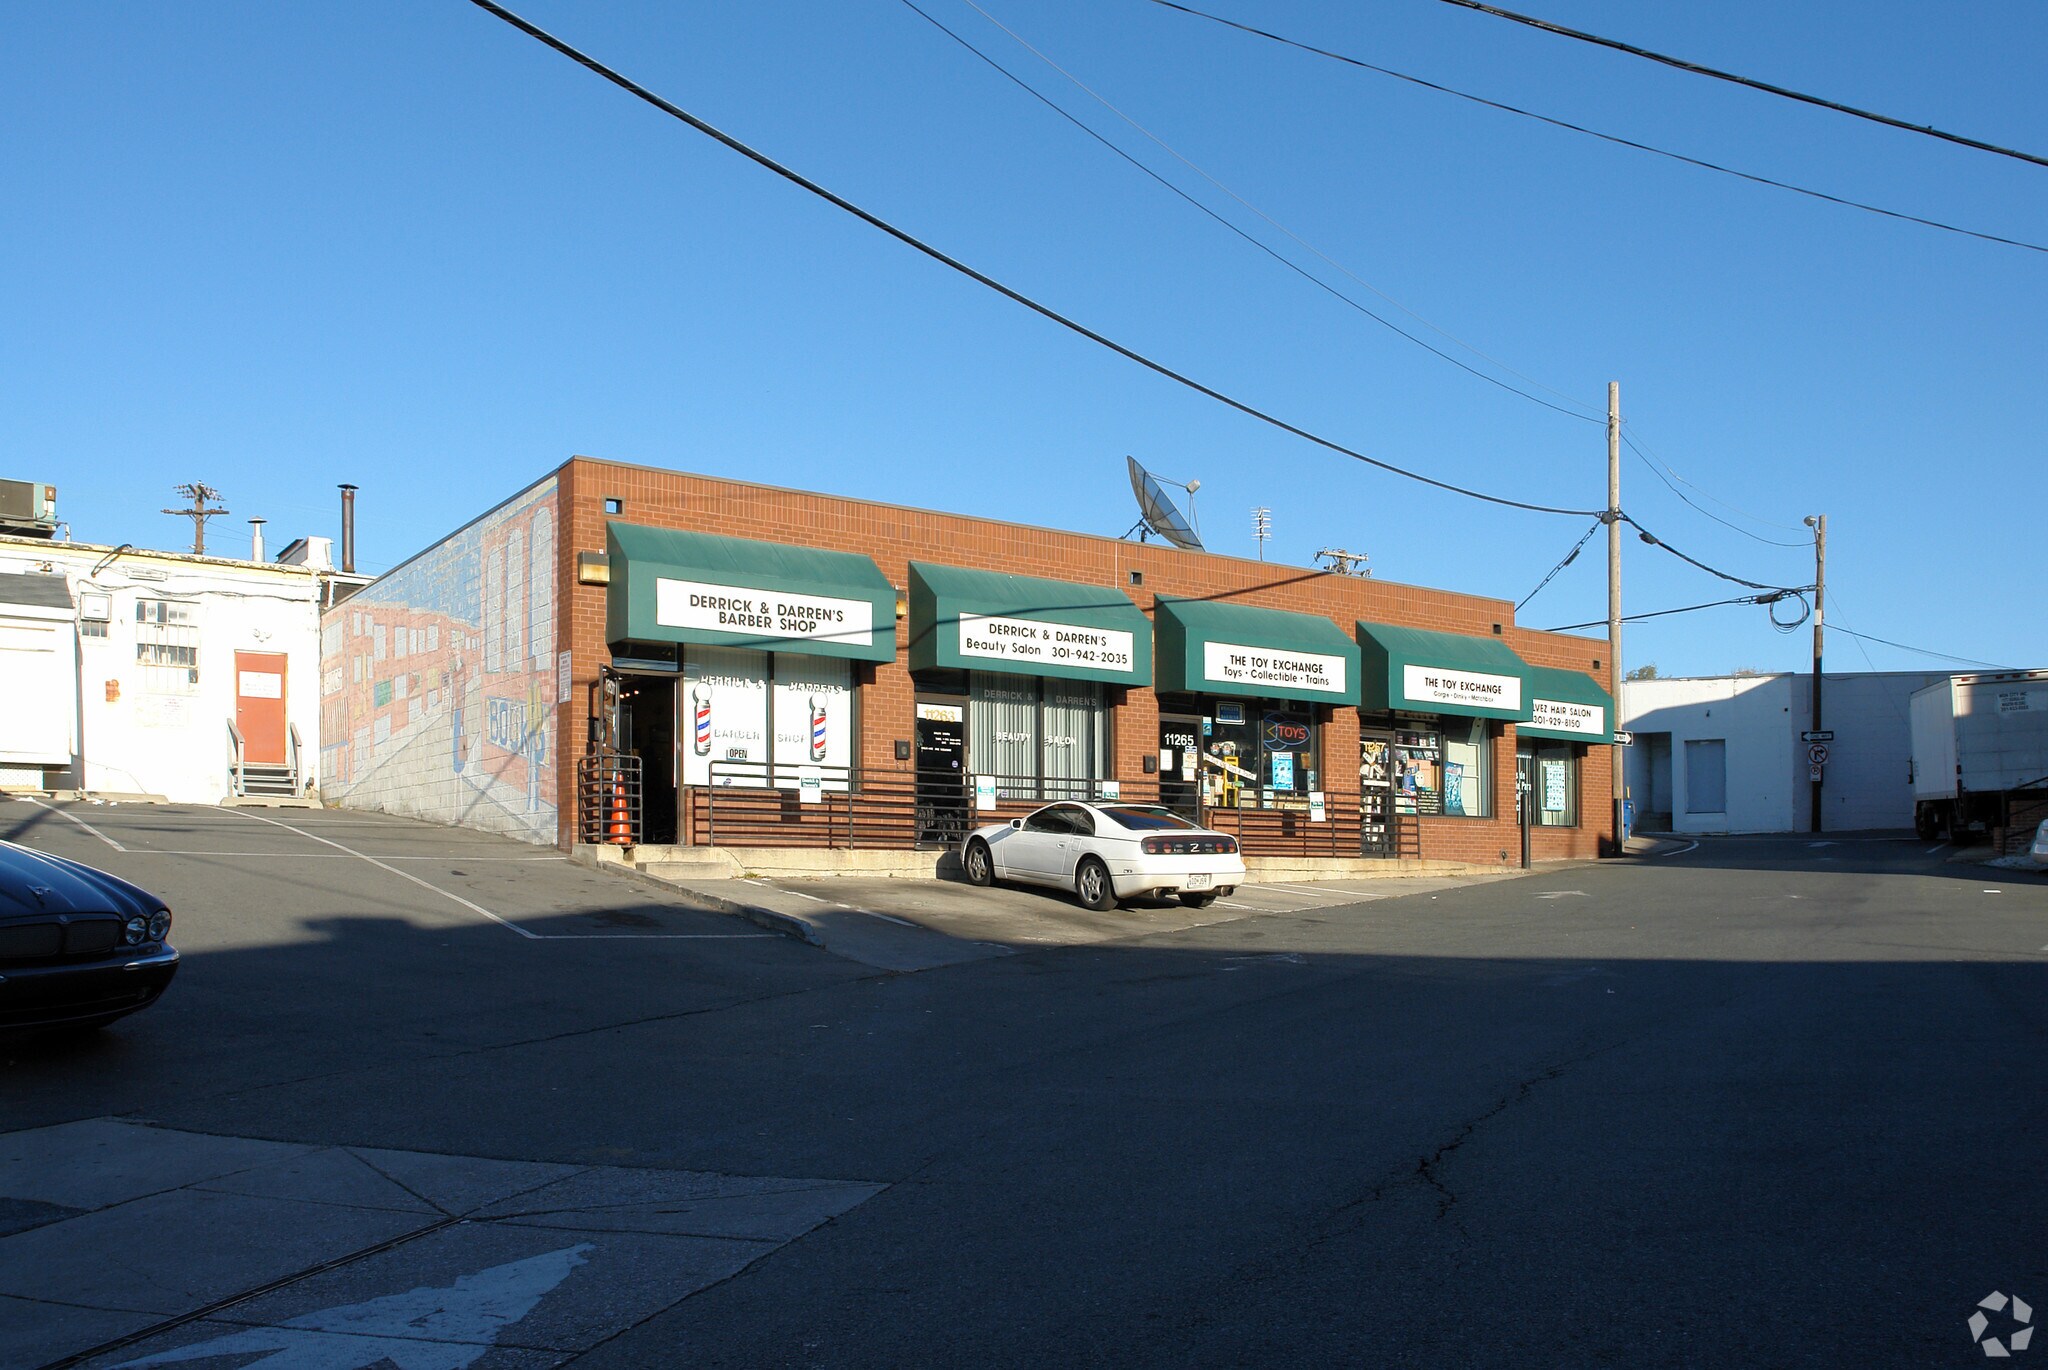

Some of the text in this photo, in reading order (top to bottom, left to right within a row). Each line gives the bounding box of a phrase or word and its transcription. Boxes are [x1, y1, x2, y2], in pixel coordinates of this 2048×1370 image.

[689, 594, 844, 622] DERRICK & DARREN'S
[718, 611, 817, 633] BARBER SHOP
[989, 623, 1107, 647] DERRICK & DARREN'S
[966, 638, 1128, 664] Beauty Salon 301-942-2035
[1230, 654, 1324, 674] THE TOY EXCHANGE
[1224, 666, 1330, 686] Toys Collectible Trains
[1425, 677, 1502, 694] THE TOY EXCHANGE
[984, 689, 1022, 700] DERRICK
[1056, 695, 1097, 706] DARREN'S
[924, 708, 956, 722] 11263
[1533, 704, 1592, 718] VEZ HAIR SALON
[1533, 715, 1581, 728] 301-929-8150
[996, 731, 1077, 746] BEAUTY SALON
[1164, 733, 1194, 746] 11265
[1278, 725, 1306, 740] TOYS
[730, 749, 748, 758] OPEN
[1190, 843, 1200, 853] Z
